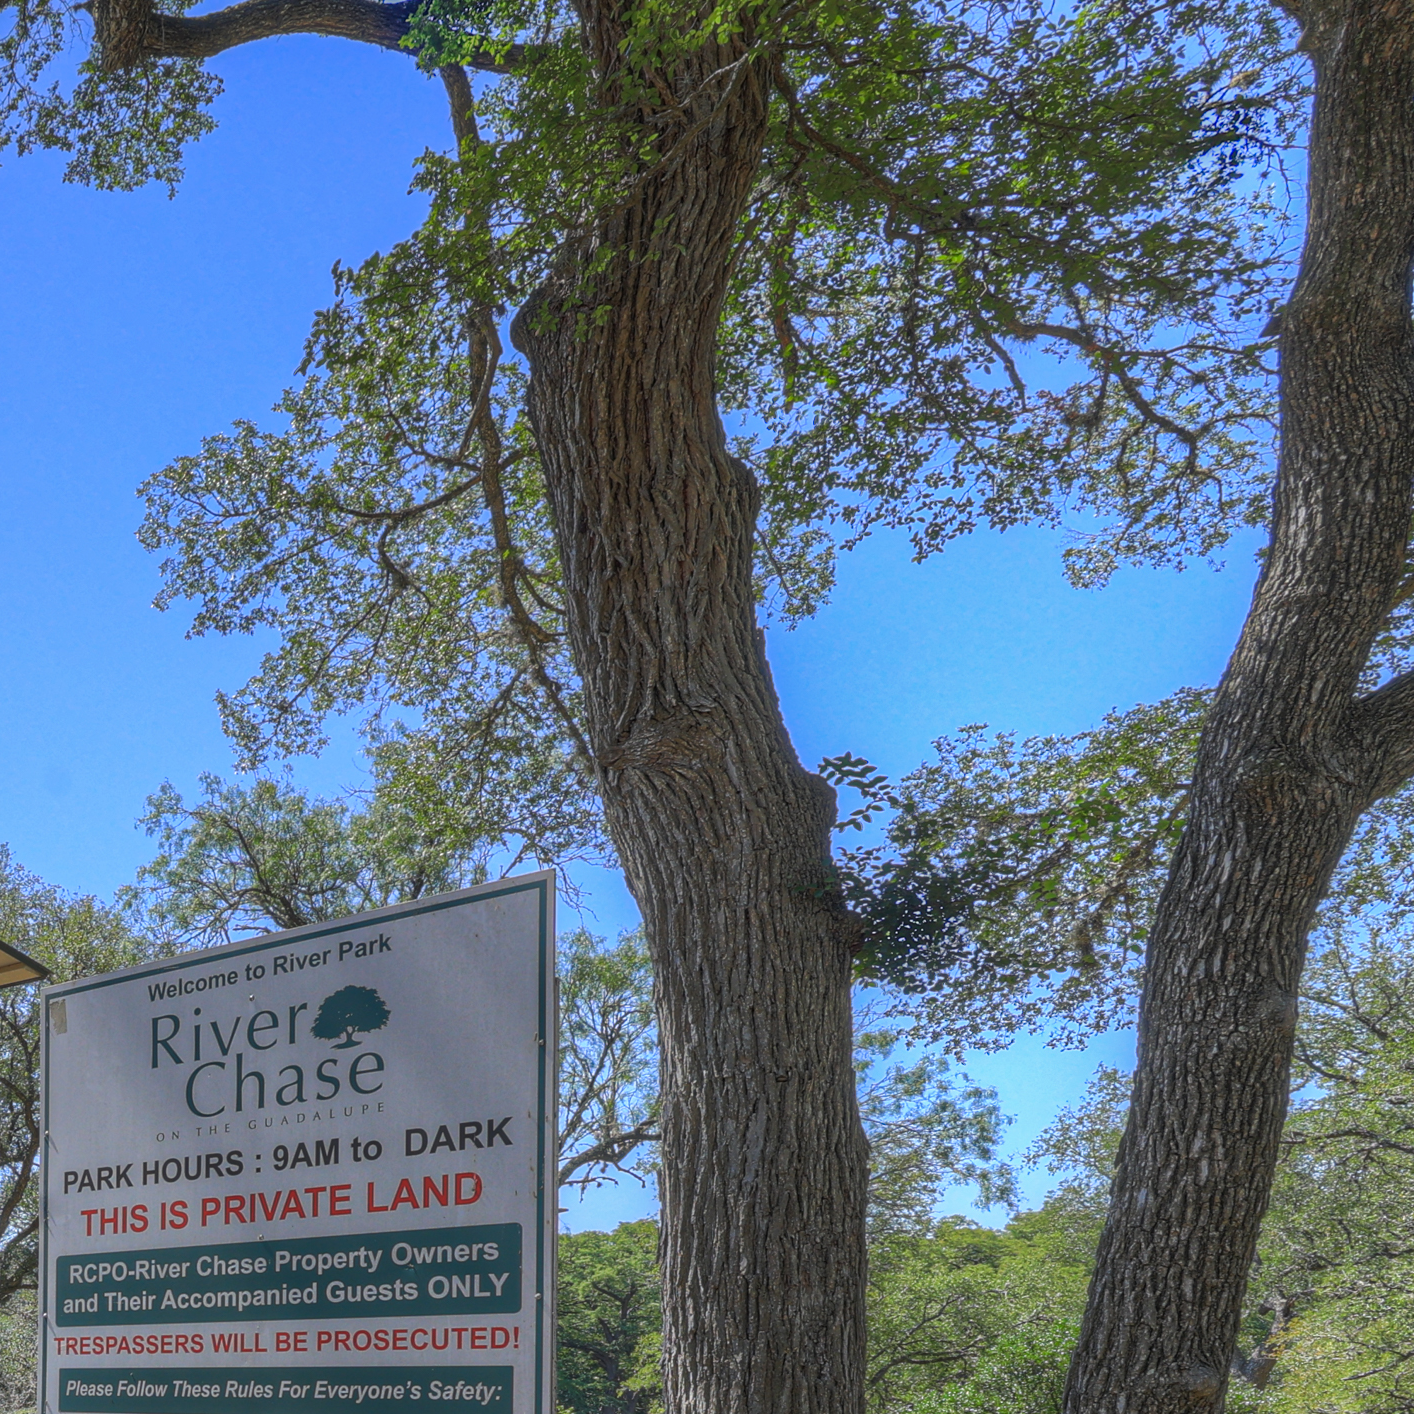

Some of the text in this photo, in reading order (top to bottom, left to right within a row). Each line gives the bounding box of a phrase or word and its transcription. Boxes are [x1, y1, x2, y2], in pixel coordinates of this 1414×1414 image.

[148, 934, 392, 1002] Welcome to River Park
[152, 1003, 308, 1069] River
[186, 1053, 385, 1120] Chase
[157, 1102, 384, 1142] ON THE GUADALUPE
[64, 1163, 134, 1194] PARK
[143, 1150, 244, 1185] HOURS
[273, 1138, 340, 1171] 9AM
[351, 1137, 383, 1162] to
[406, 1117, 514, 1156] DARK
[81, 1172, 483, 1236] THIS IS PRIVATE LAND
[70, 1239, 500, 1283] RCPO-River Chase Property Owners
[64, 1273, 510, 1313] and Their Accompanied Guests ONLY
[54, 1327, 520, 1355] TRESPASSERS WILL BE PROSECUTED!
[66, 1380, 503, 1405] Please Follow These Rules For Everyone’s Safety:
